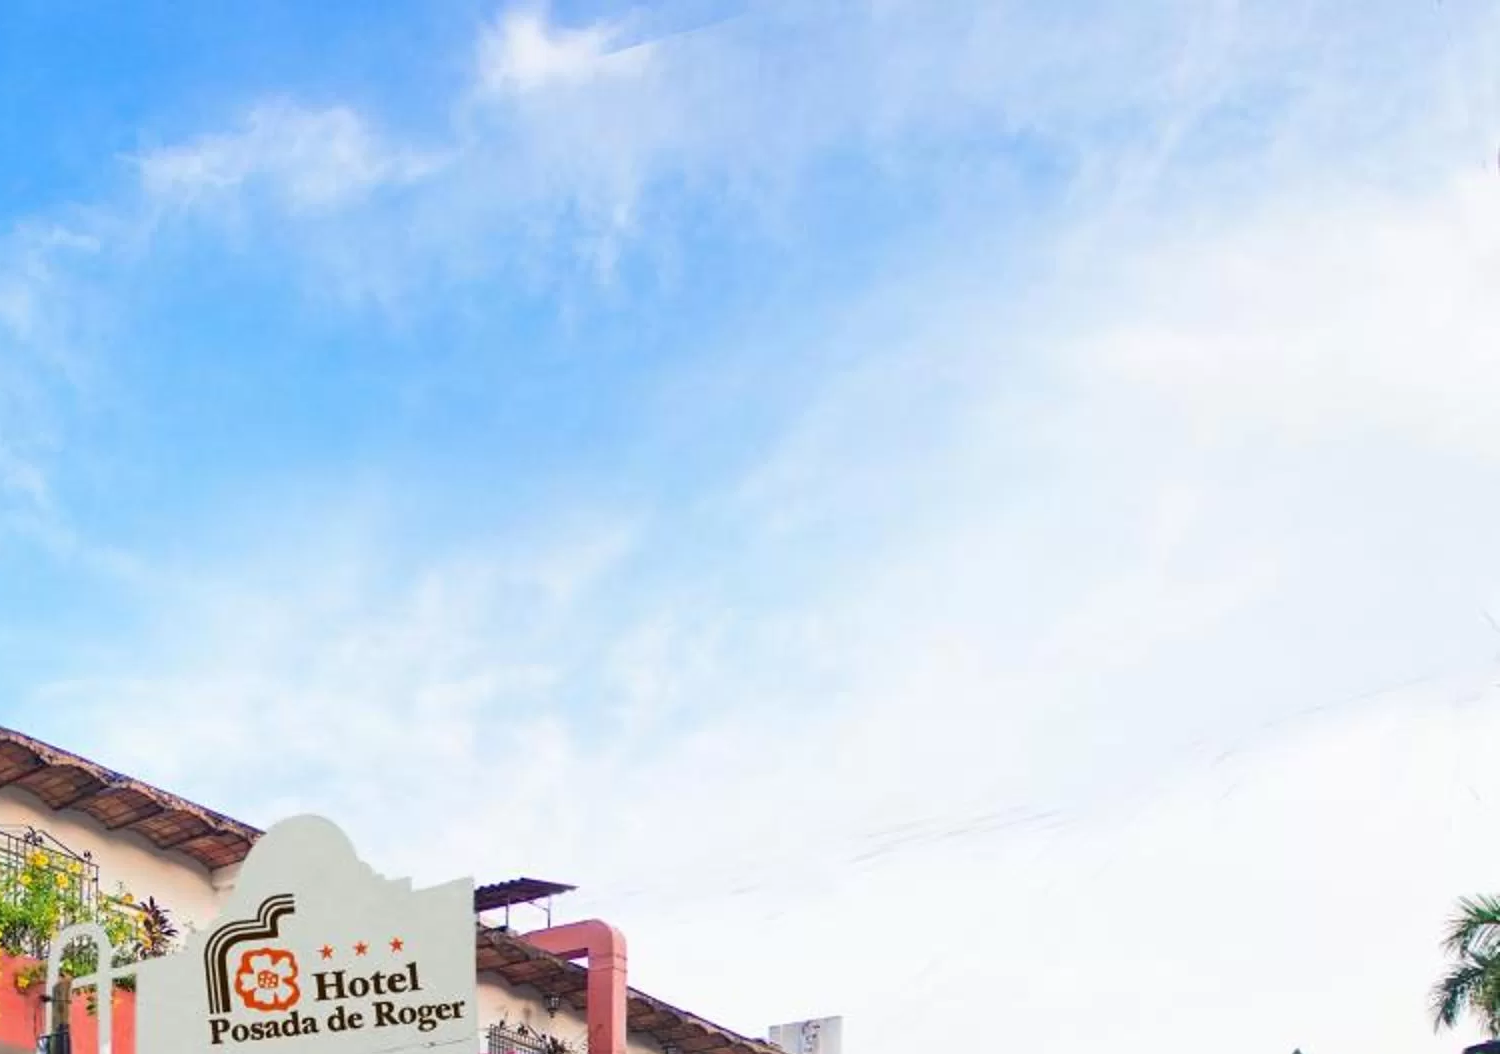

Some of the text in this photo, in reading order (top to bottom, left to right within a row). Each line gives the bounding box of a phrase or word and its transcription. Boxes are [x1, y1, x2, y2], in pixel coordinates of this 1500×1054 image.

[312, 962, 424, 1002] Hotel
[209, 999, 466, 1045] Posada de Roger
